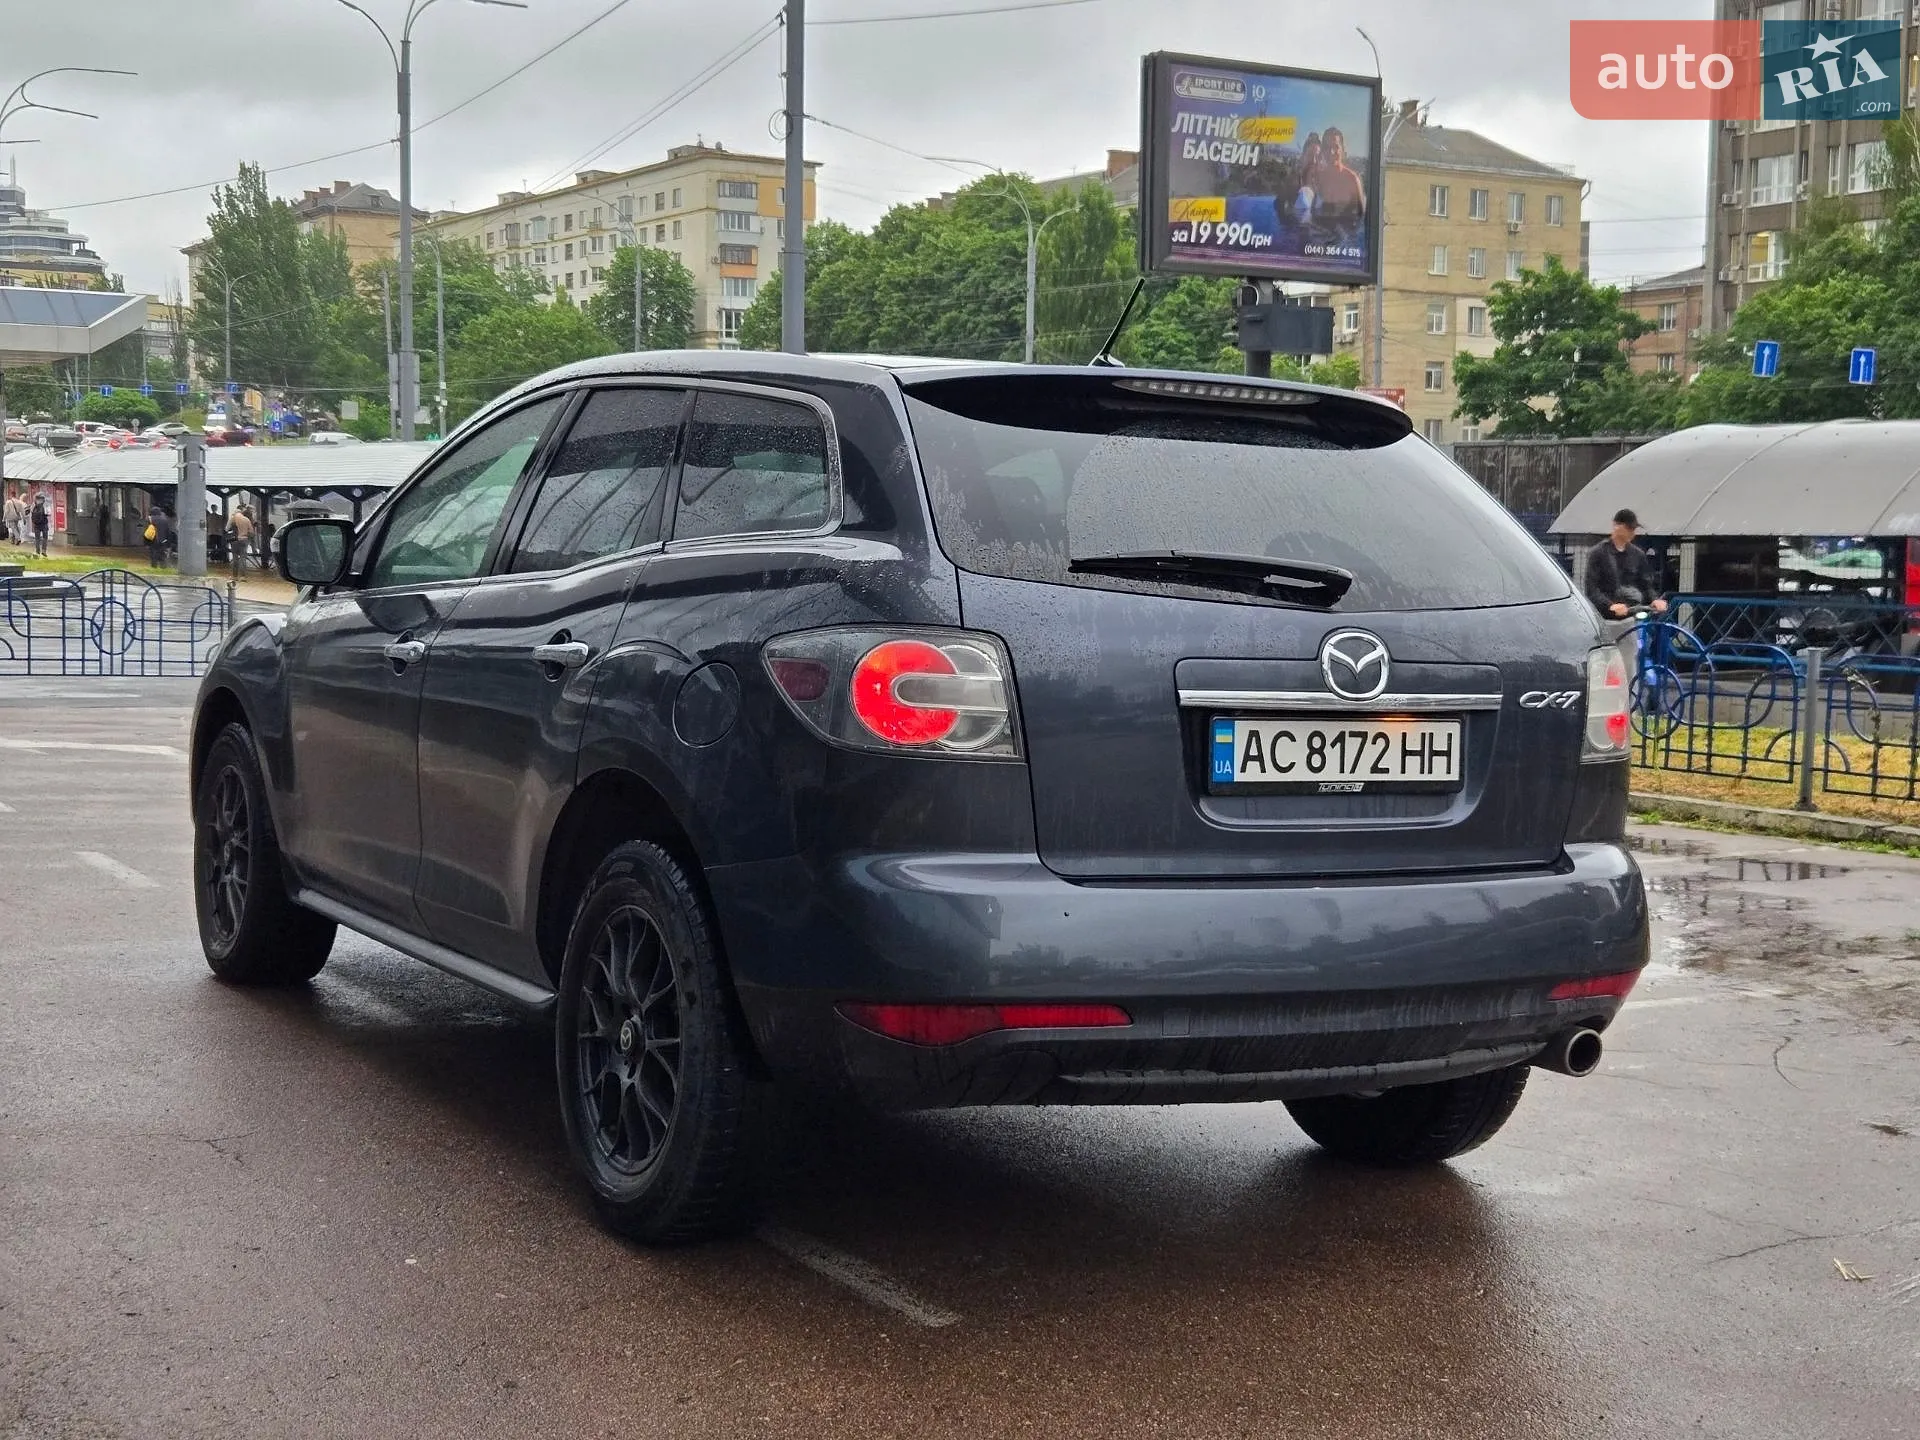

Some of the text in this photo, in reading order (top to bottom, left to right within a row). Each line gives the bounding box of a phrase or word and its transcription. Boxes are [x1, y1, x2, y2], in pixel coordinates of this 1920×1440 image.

[1171, 111, 1240, 140] ЛІТНІЙ
[1182, 138, 1259, 166] БАСЕЙН
[1171, 220, 1272, 248] за 19 990 грн
[1518, 690, 1580, 709] CX-7
[1239, 729, 1453, 775] AC 8172 HH
[1214, 760, 1232, 774] UA
